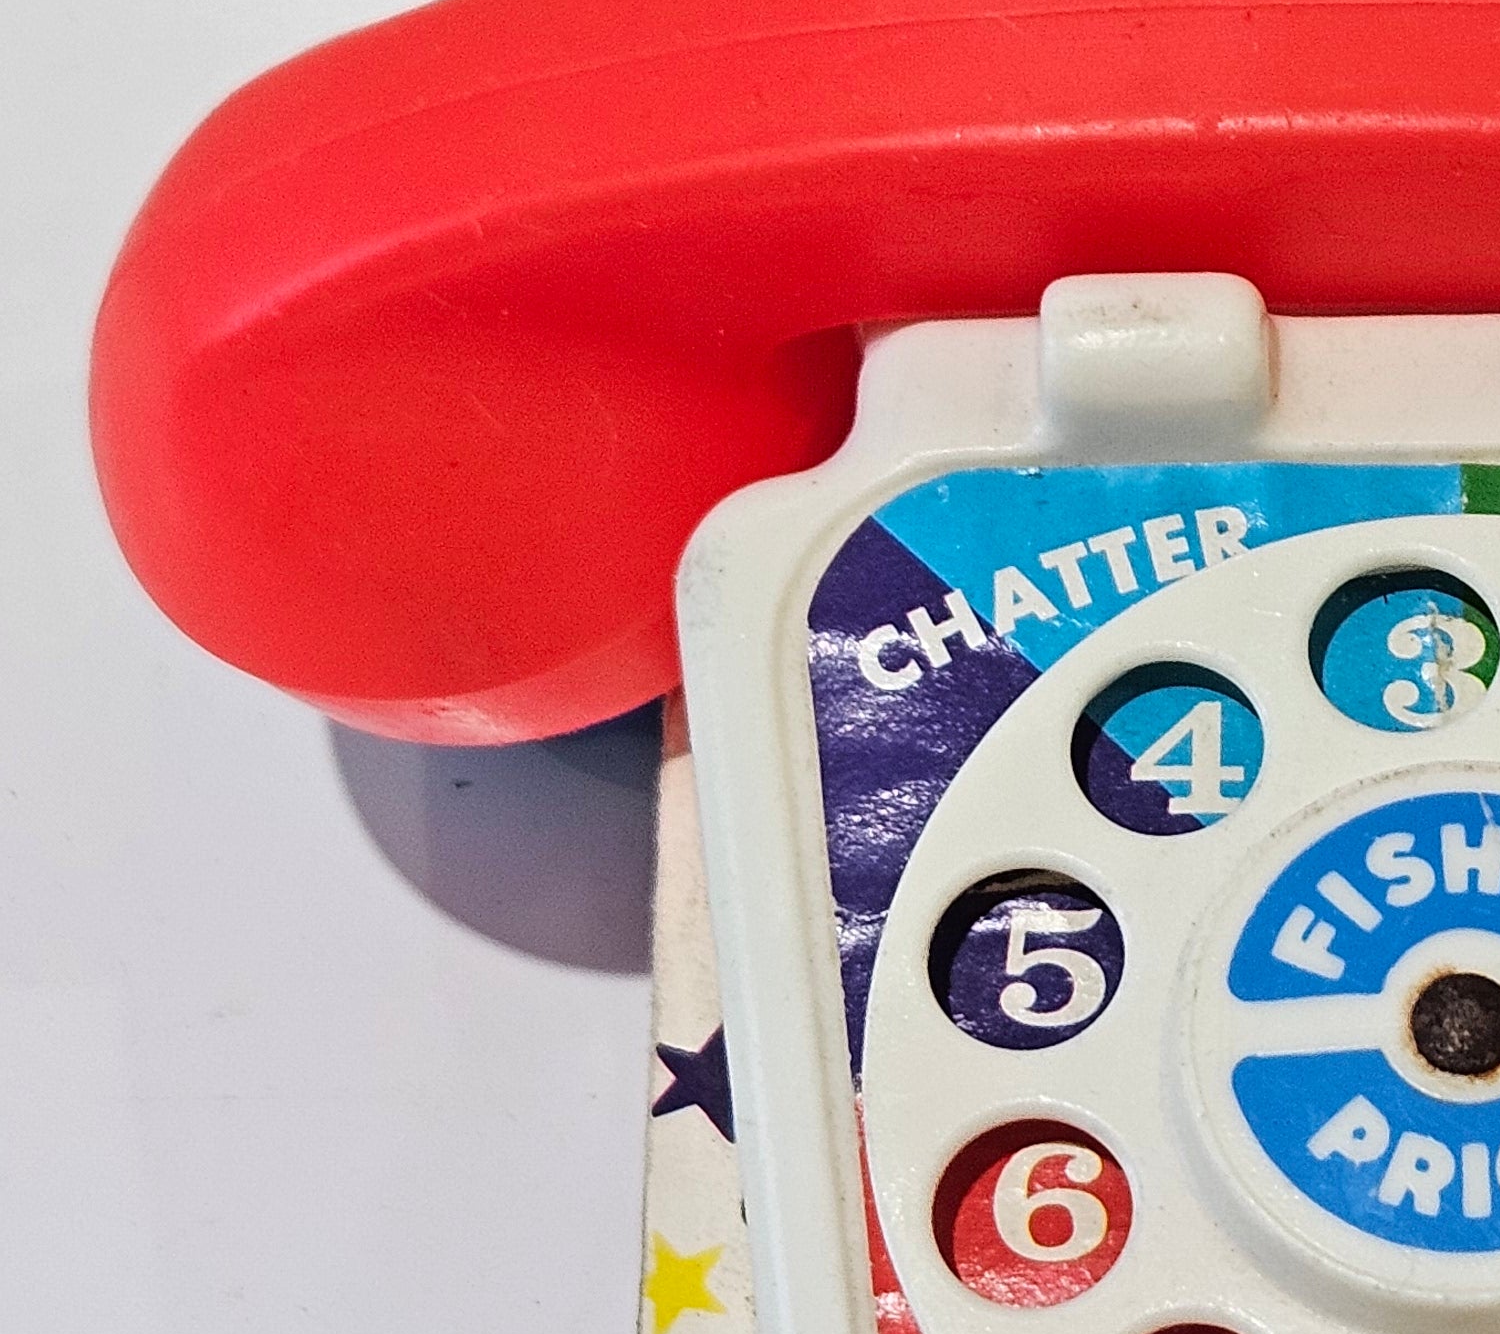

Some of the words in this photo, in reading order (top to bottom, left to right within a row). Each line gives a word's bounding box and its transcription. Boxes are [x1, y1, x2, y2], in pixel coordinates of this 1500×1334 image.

[857, 505, 1254, 691] CHATTER
[1382, 613, 1487, 728] 3
[1130, 700, 1245, 815] 4
[998, 908, 1106, 1028] 5
[992, 1141, 1108, 1263] 6
